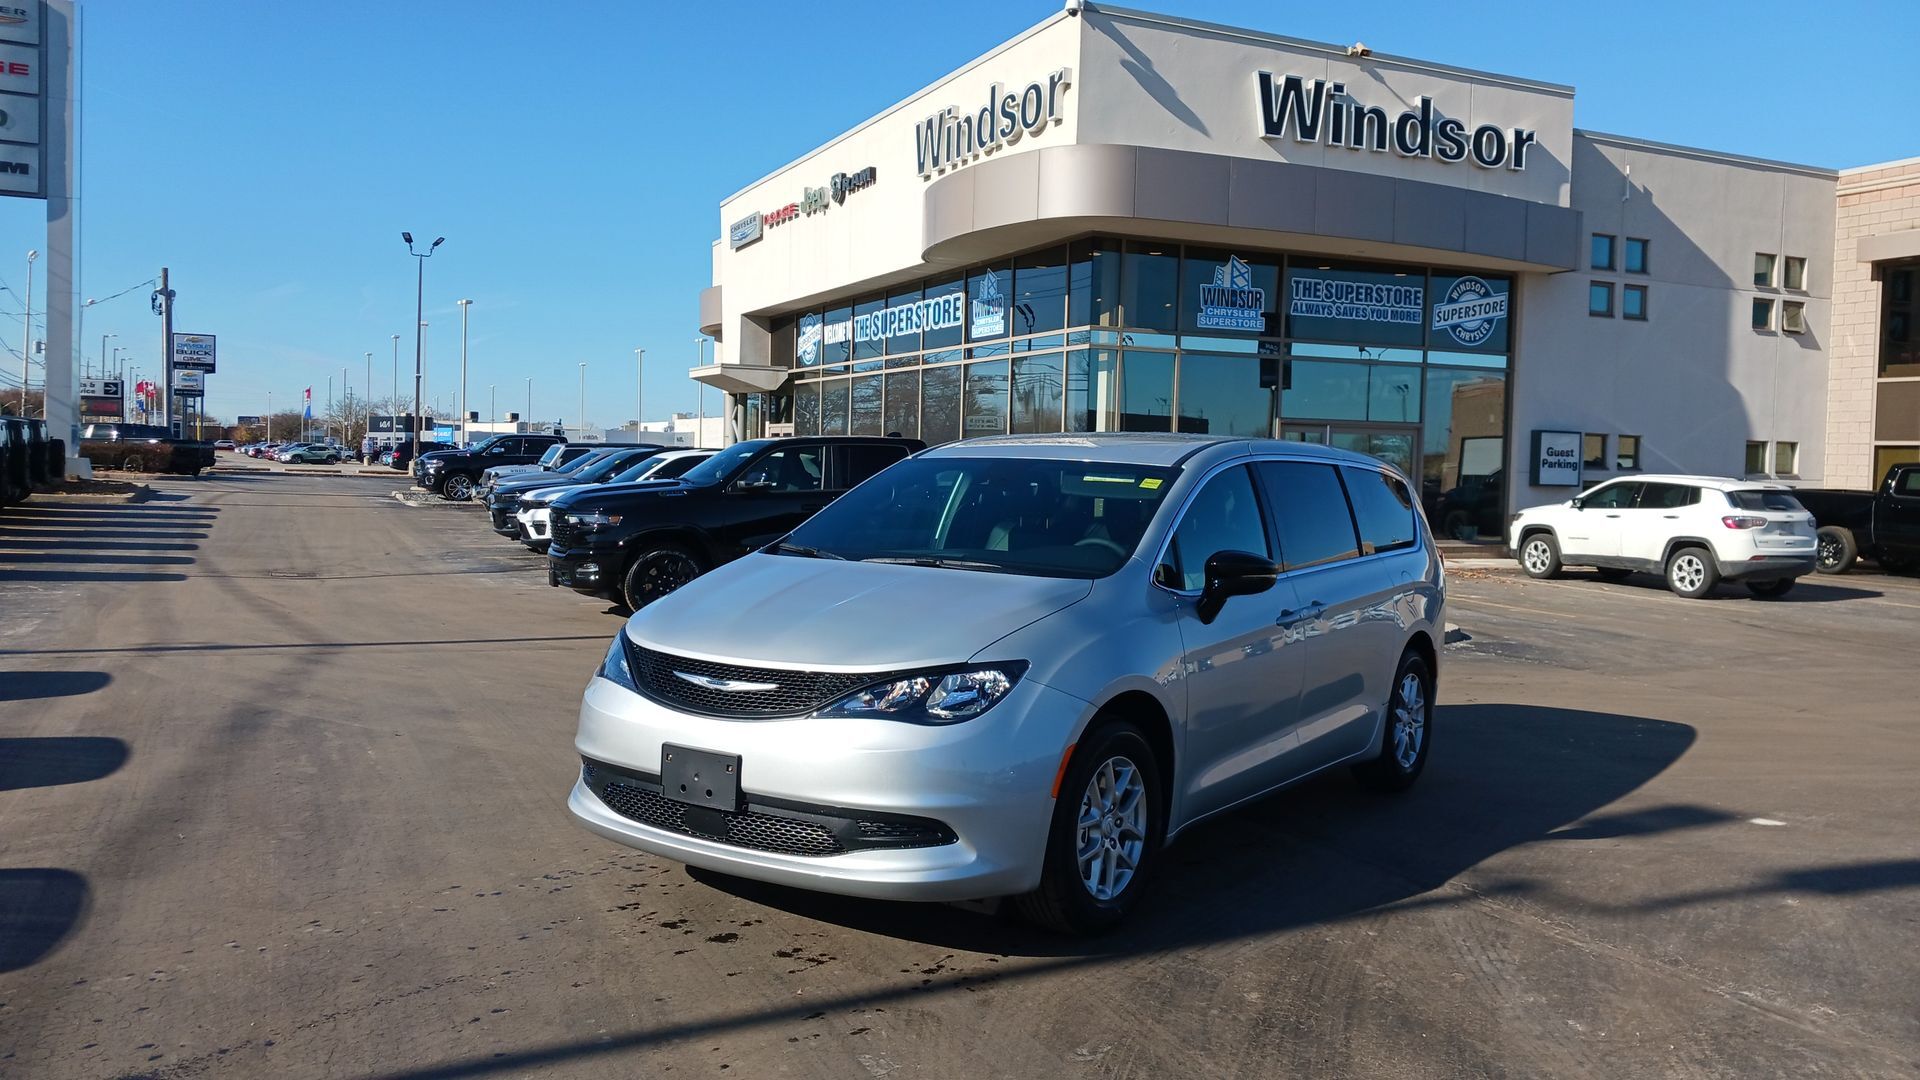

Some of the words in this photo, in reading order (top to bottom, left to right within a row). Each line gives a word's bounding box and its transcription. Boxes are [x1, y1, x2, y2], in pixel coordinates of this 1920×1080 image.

[915, 68, 1071, 178] Windsor
[1252, 70, 1536, 171] Windsor
[842, 167, 876, 194] RAM
[801, 187, 830, 214] Jeep
[730, 215, 757, 234] CHRYSLER
[764, 203, 799, 226] DODGE
[1202, 287, 1262, 309] WINDSOR
[1293, 279, 1322, 300] THE
[1324, 281, 1422, 307] SUPERSTORE
[1451, 282, 1486, 300] WINDSOR
[855, 315, 870, 340] THE
[871, 295, 962, 338] SUPERSTORE
[1200, 317, 1263, 328] SUPERSTORE
[1207, 308, 1256, 317] CHRYSLER
[1292, 301, 1333, 316] ALWAYS
[1335, 304, 1368, 319] SAVES
[1370, 306, 1389, 321] YOU
[1390, 309, 1421, 323] MORE!
[1436, 300, 1505, 323] SUPERSTORE
[1456, 322, 1490, 341] CHRYSLER
[1546, 447, 1574, 457] Guest
[1542, 459, 1578, 471] Parking
